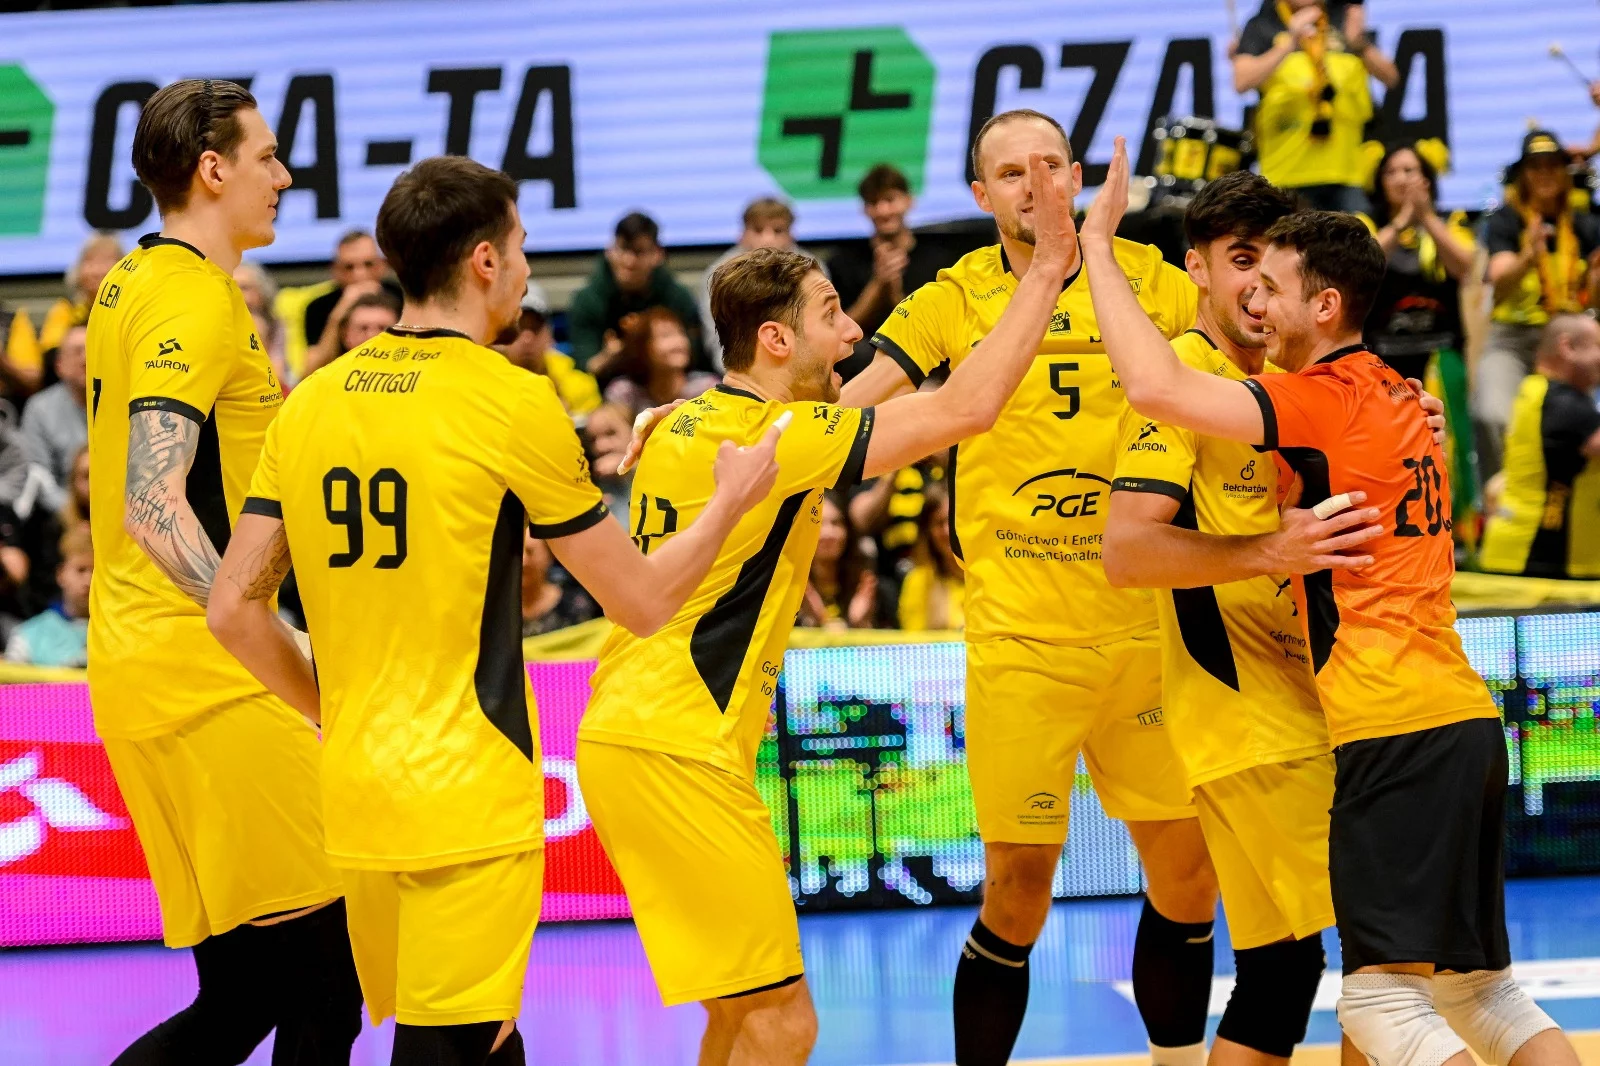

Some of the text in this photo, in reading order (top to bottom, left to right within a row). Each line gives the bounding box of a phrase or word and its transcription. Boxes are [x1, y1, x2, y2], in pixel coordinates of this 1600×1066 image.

[84, 63, 577, 230] CA-TA
[356, 347, 441, 361] plus liga
[145, 360, 190, 373] TAURON
[344, 370, 421, 393] CHITIGOI
[1049, 362, 1080, 420] 5
[1223, 483, 1268, 493] Bełchatów
[1394, 455, 1442, 537] 20
[1030, 491, 1101, 518] PGE
[322, 466, 408, 570] 99
[996, 529, 1059, 546] Górnictwo
[1063, 535, 1068, 545] i
[1031, 800, 1056, 810] PGE
